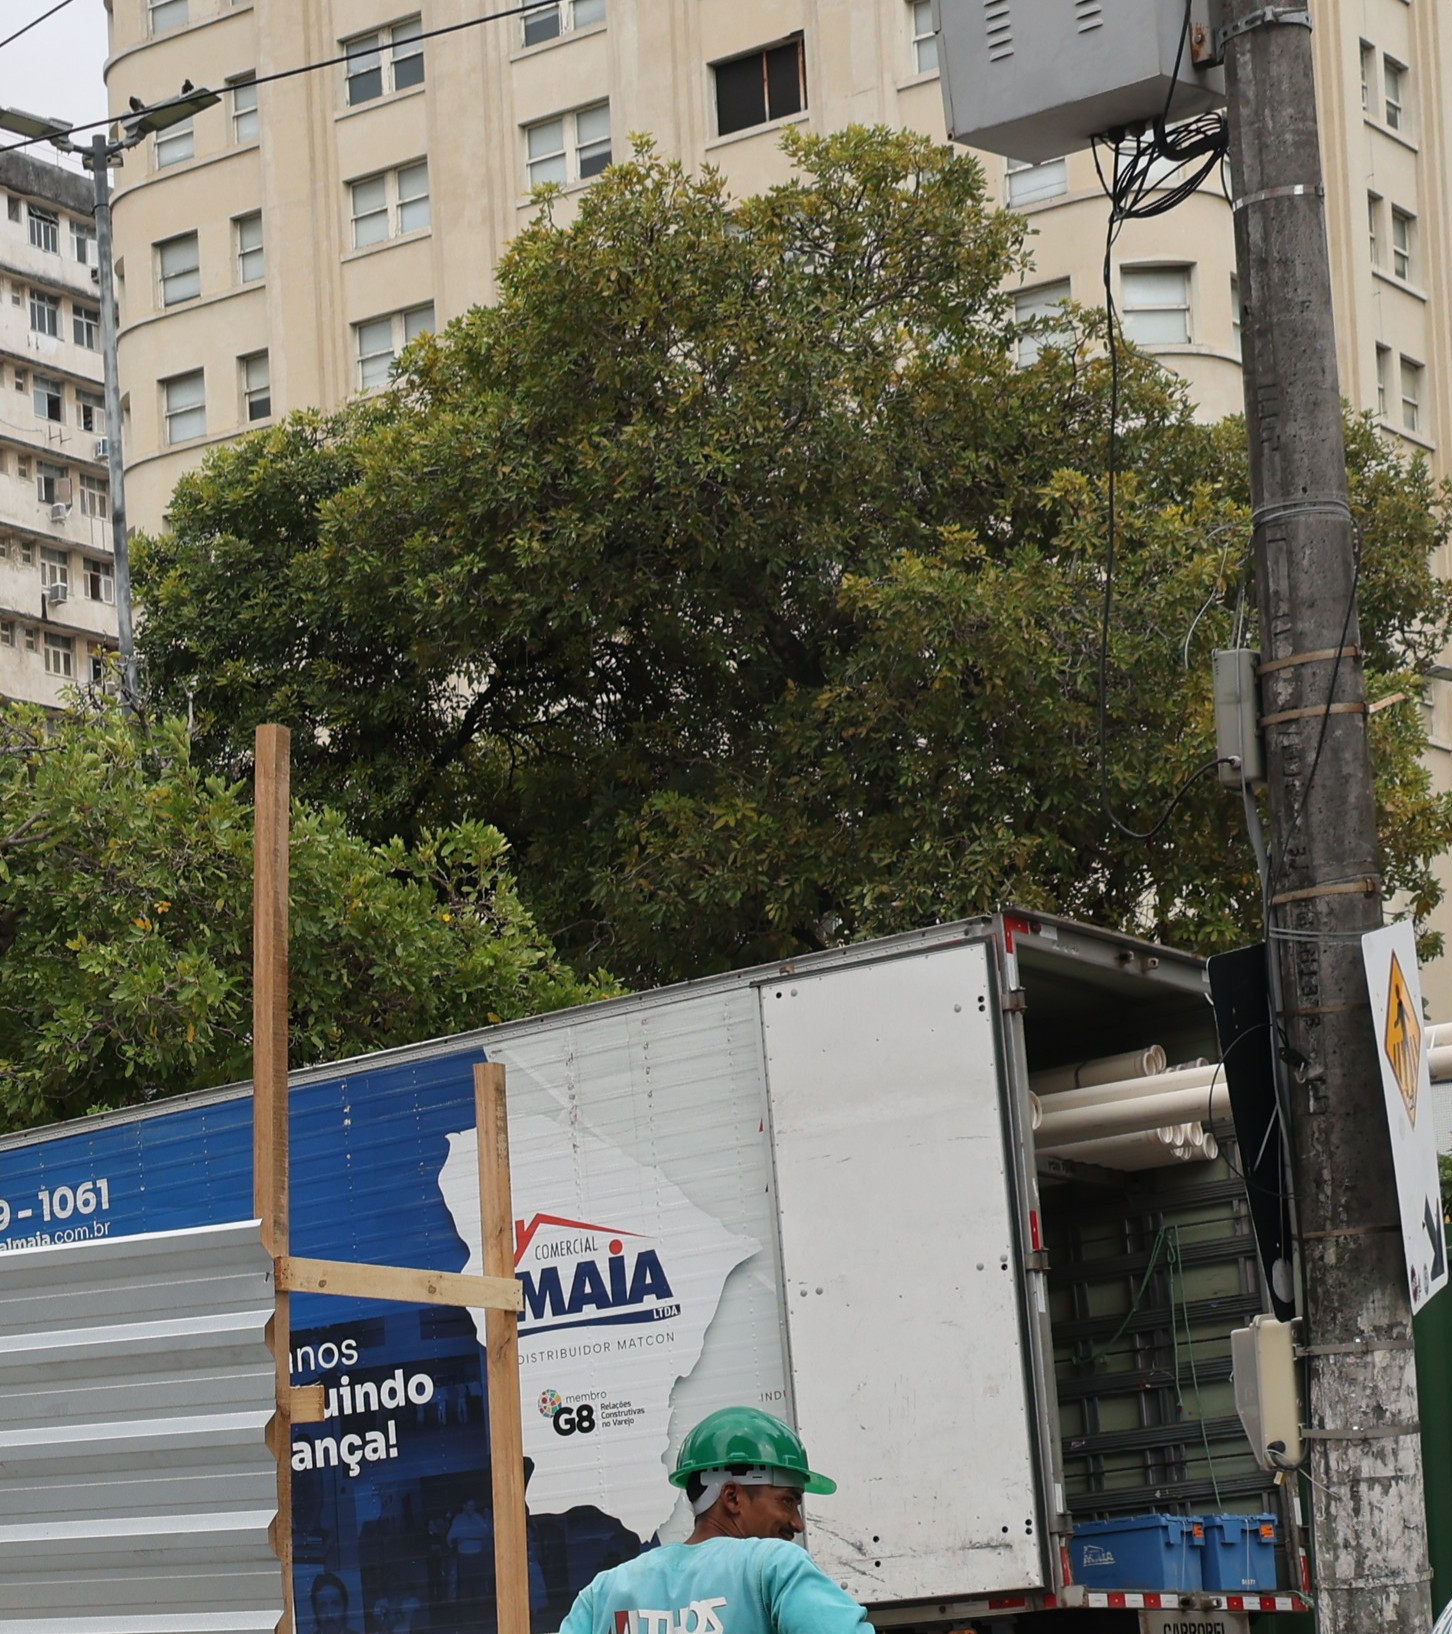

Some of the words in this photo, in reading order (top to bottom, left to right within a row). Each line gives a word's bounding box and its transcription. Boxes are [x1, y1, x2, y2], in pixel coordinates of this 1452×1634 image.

[37, 1178, 110, 1222] 1061
[535, 1236, 599, 1260] COMERCIAL
[515, 1239, 674, 1322] MAIA
[653, 1305, 679, 1319] LTDA
[518, 1342, 611, 1366] DISTRIBUIDOR
[617, 1332, 676, 1350] MATCON
[565, 1389, 607, 1404] membro
[600, 1400, 632, 1411] Relações
[552, 1404, 596, 1436] G8
[601, 1408, 646, 1420] Construtivas
[612, 1417, 635, 1427] Varejo
